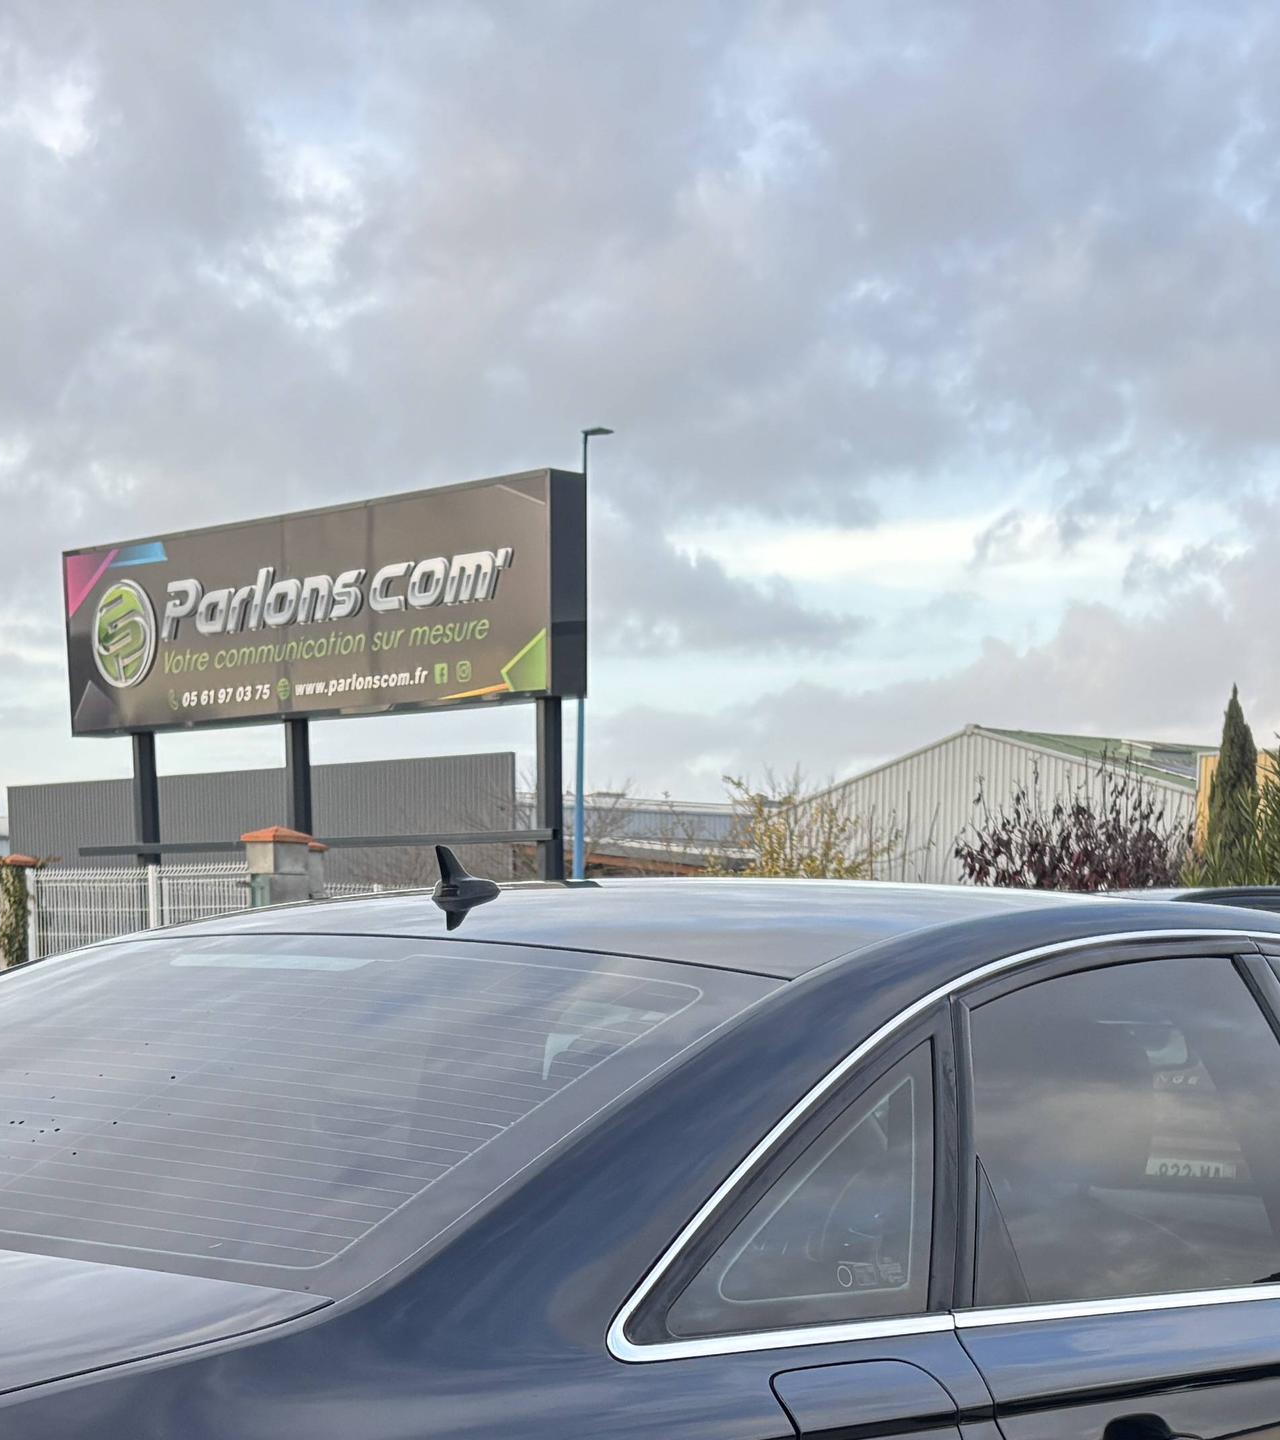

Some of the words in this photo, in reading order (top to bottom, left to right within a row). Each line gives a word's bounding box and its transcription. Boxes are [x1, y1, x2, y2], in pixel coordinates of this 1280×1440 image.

[161, 566, 366, 642] Parlons
[163, 650, 209, 675] Votre
[214, 627, 366, 669] communication
[371, 630, 401, 652] sur
[408, 618, 489, 648] mesure
[182, 690, 198, 708] 05
[200, 689, 215, 706] 61
[217, 687, 234, 704] 97
[235, 685, 252, 702] 03
[255, 683, 271, 700] 75
[294, 666, 429, 696] www.parlonscom.fr
